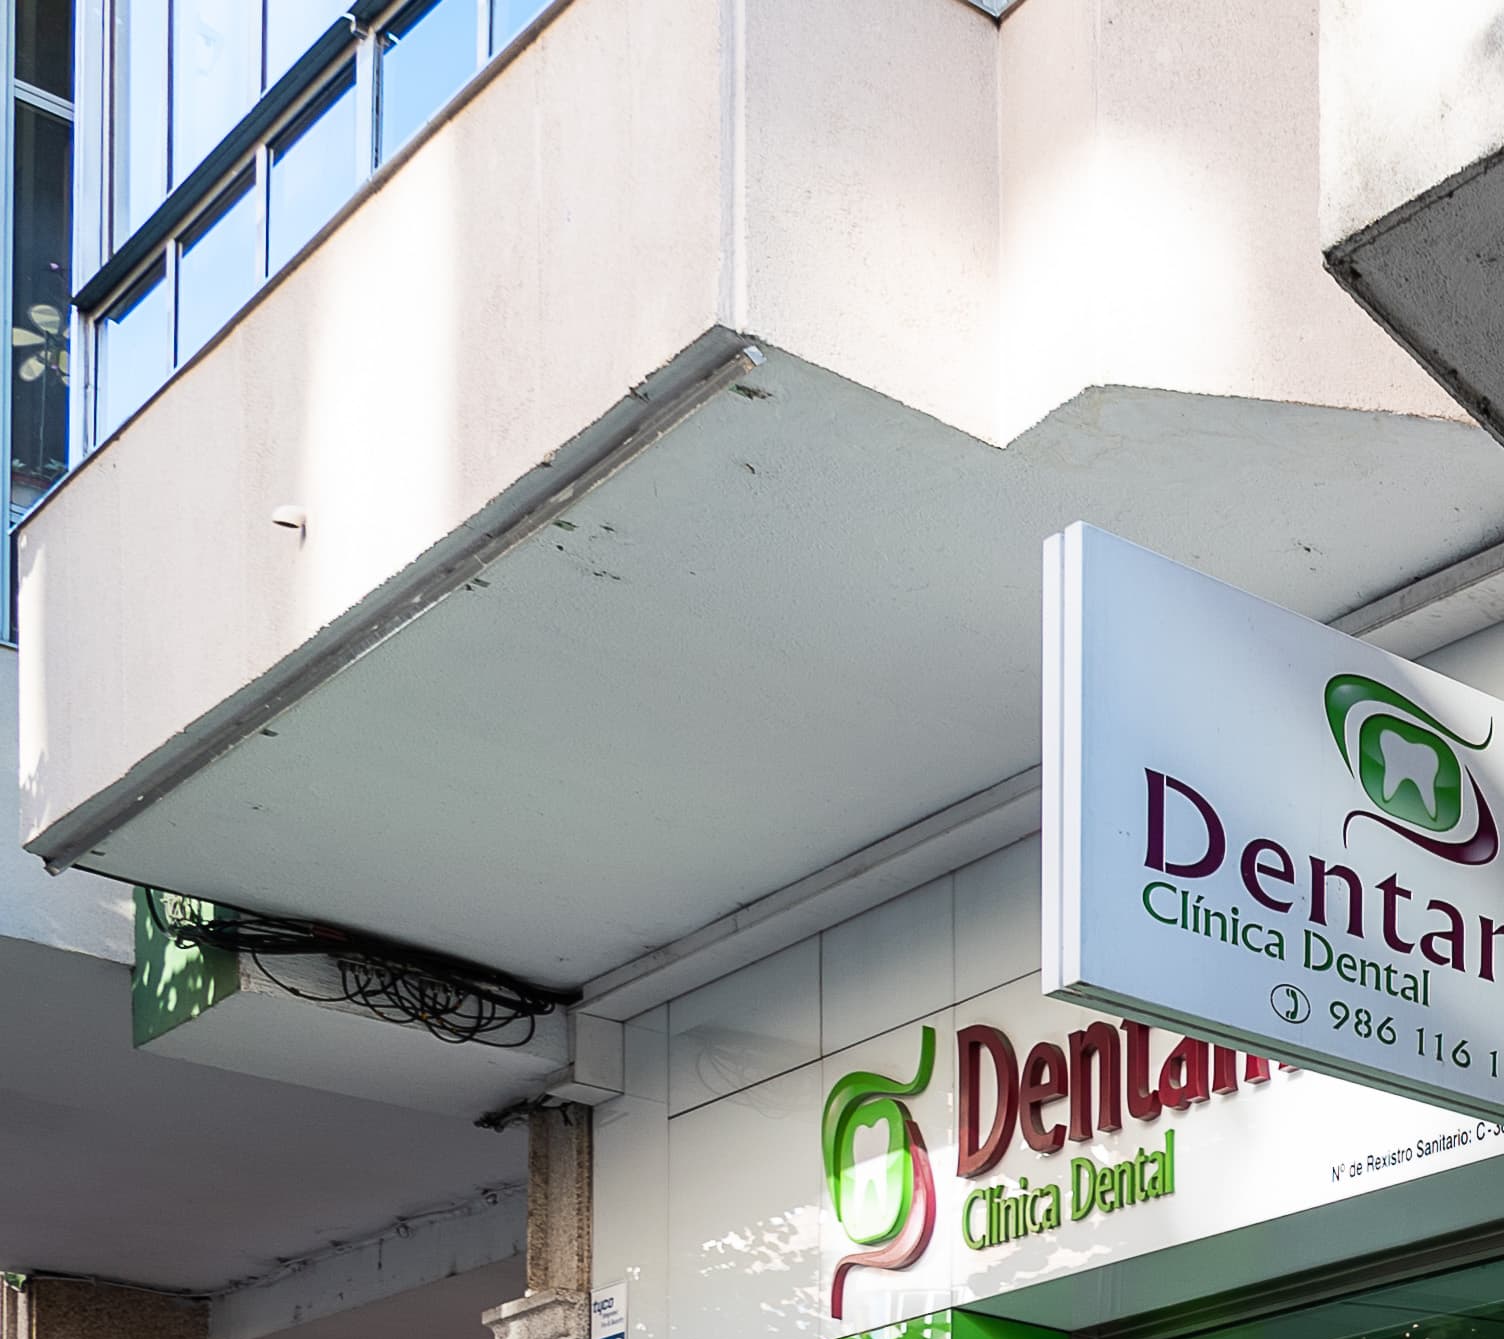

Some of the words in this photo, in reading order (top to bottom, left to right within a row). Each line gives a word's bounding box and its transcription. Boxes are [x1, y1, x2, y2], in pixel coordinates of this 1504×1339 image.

[1142, 881, 1286, 962] Clínica
[1302, 929, 1431, 1008] Dental
[1328, 1000, 1398, 1047] 986
[1415, 1026, 1473, 1071] 116
[962, 1176, 1062, 1251] Clínica
[1070, 1128, 1176, 1222] Dental
[1349, 1161, 1363, 1178] de
[1366, 1146, 1413, 1173] Rexistro
[1416, 1128, 1473, 1159] Sanitario:
